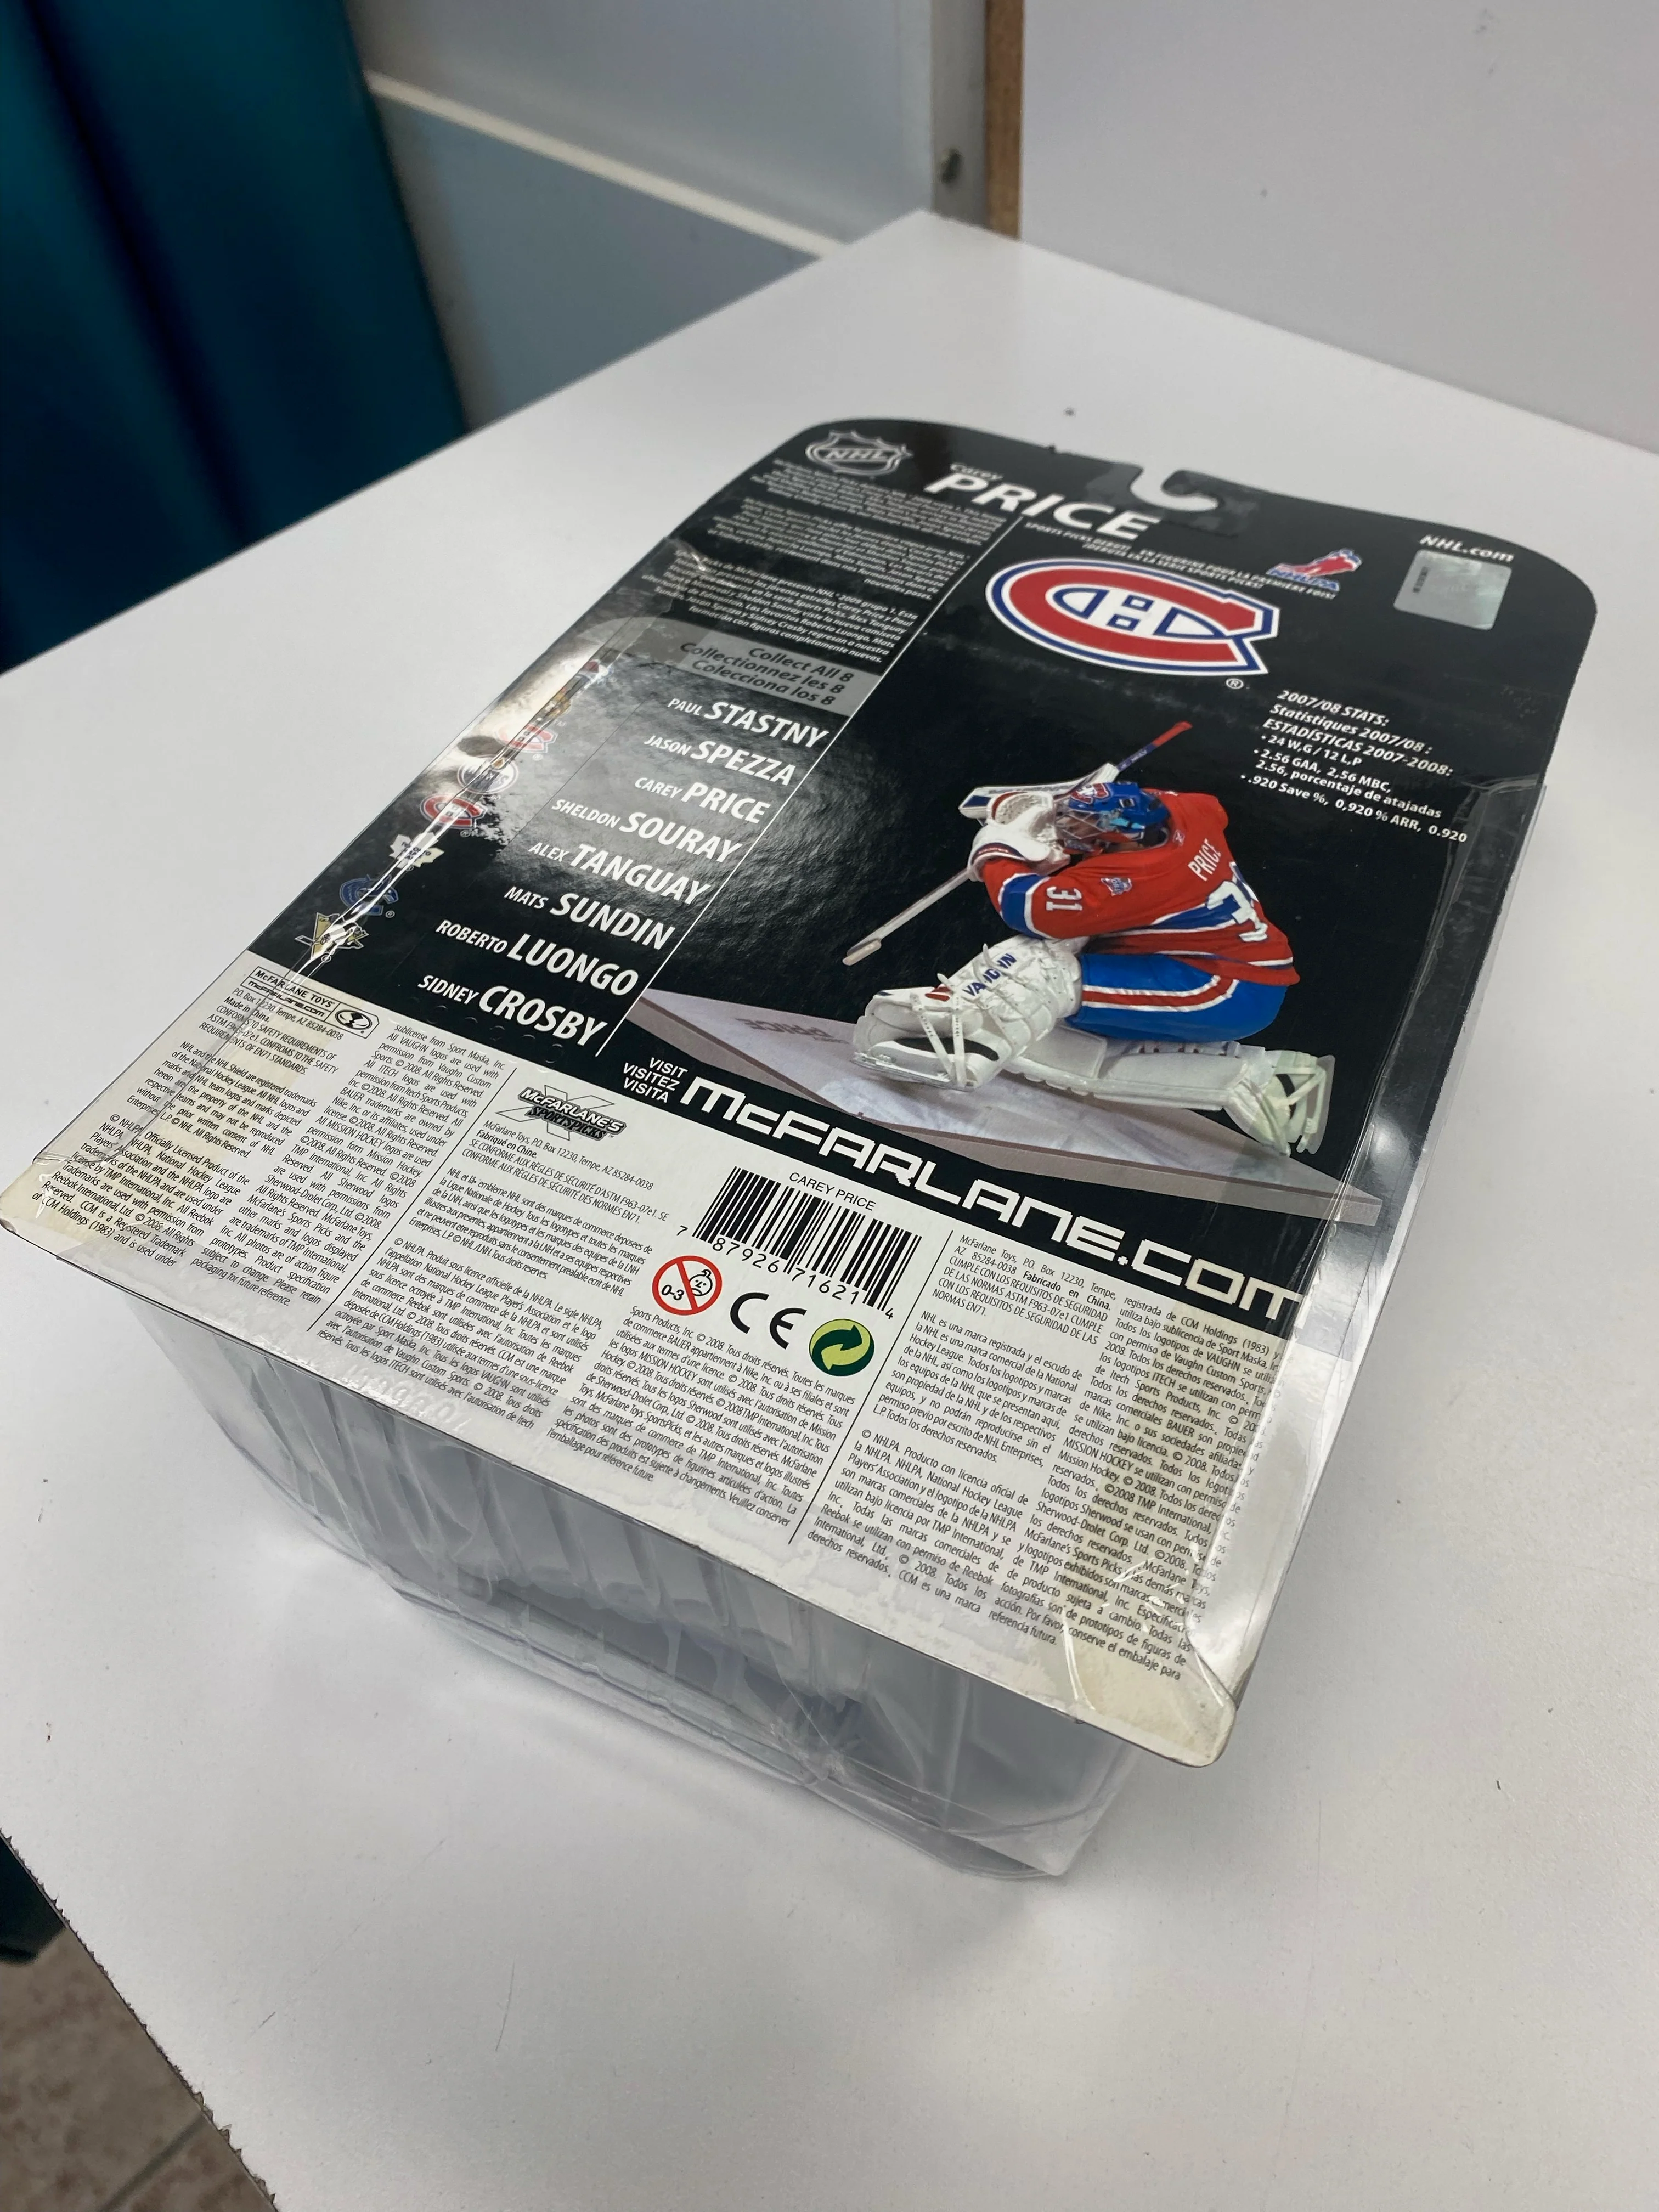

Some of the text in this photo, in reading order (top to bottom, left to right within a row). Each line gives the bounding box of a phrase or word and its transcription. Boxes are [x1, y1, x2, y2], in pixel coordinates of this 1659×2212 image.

[826, 447, 892, 465] NHL
[924, 473, 1159, 539] PRICE
[1420, 535, 1514, 561] NHL.com
[680, 642, 845, 693] Collectionnez les 8
[692, 659, 835, 704] Colecciona los 8
[749, 648, 854, 682] Collect All 8
[667, 698, 829, 747] PAUL STASTNY
[1270, 704, 1358, 734] Statistiques
[1358, 727, 1424, 751] 2007/08
[1277, 690, 1389, 726] 2007/08 STATS:
[644, 735, 795, 786] JASON SPEZZA
[1262, 718, 1453, 776] ESTADÍSTICAS 2007-2008:
[1268, 735, 1285, 746] 24
[1288, 739, 1312, 753] W,G
[1324, 749, 1339, 760] 12
[1340, 754, 1362, 765] L,P
[1256, 759, 1441, 817] 2.56, porcentaje de atajadas
[1260, 749, 1391, 793] 2.56 GAA, 2,56 MBC,
[635, 777, 771, 823] CAREY PRICE
[1278, 783, 1310, 798] Save
[1335, 799, 1373, 816] 0,920
[1390, 815, 1421, 831] ARR,
[1428, 825, 1467, 842] 0.920
[551, 799, 743, 862] SHELDON SOURAY
[528, 842, 713, 906] ALEX TANGUAY
[504, 886, 675, 950] MATS SUNDIN
[436, 919, 638, 995] ROBERTO LUONGO
[223, 996, 243, 1009] Made
[311, 994, 332, 1007] TOYS
[417, 975, 607, 1046] SIDNEY CROSBY
[386, 1032, 499, 1079] All VAUGHN logos are used with
[623, 1062, 680, 1091] VISITEZ
[649, 1057, 688, 1077] VISIT
[624, 1077, 668, 1103] VISITA
[476, 1130, 537, 1158] Fabriqué en Chine.
[483, 1120, 653, 1190] McFarlane Toys, P.O. Box 12230, Tempe, AZ 85284-0038
[462, 1148, 640, 1222] CONFORME AUX RÈGLES DE SÉCURITÉ DES NORMES EN71.
[789, 1172, 876, 1211] CAREY PRICE
[676, 1225, 688, 1236] 7
[712, 1238, 779, 1273] 87926
[954, 1245, 1110, 1310] AZ 85284-0038 Fabricado en China.
[190, 1258, 290, 1306] packaging for future reference.
[661, 1284, 687, 1300] 0-3
[792, 1267, 859, 1304] 71621
[932, 1288, 985, 1316] NORMAS EN71.
[884, 1308, 893, 1319] 4
[988, 1611, 1056, 1644] referencia futura.
